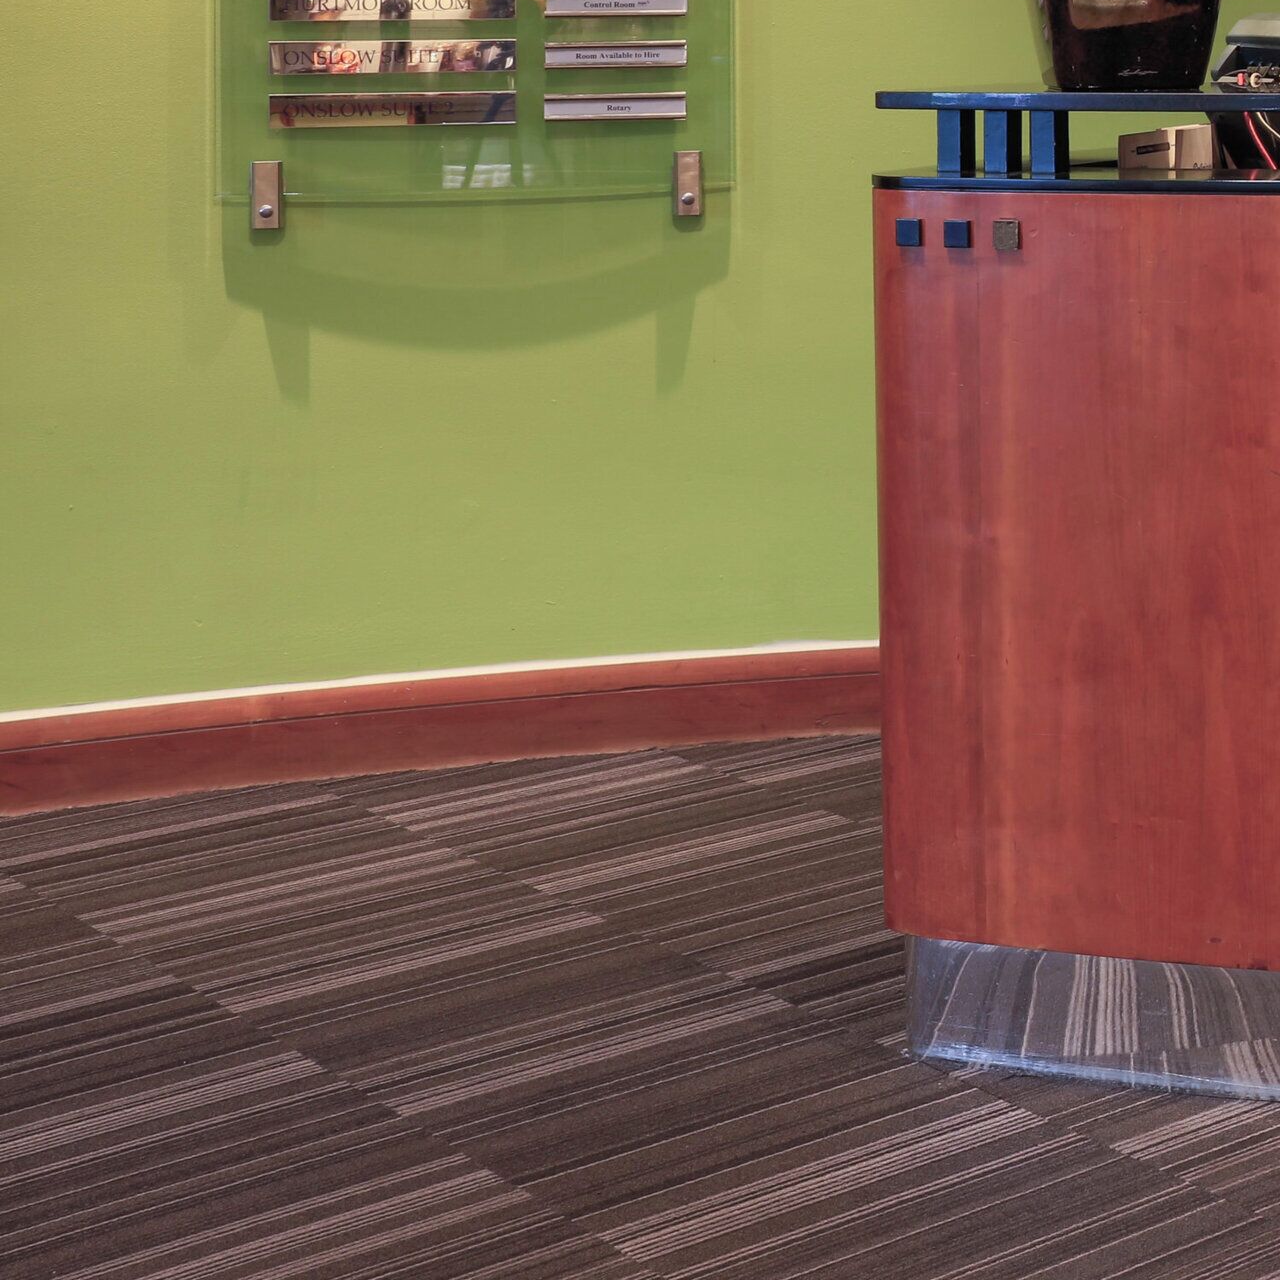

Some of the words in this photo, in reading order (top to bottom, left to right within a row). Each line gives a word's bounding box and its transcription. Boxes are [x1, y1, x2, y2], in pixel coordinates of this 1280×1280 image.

[583, 0, 612, 8] Control
[284, 50, 376, 65] ONSLOW
[382, 50, 438, 64] SUITE
[644, 51, 660, 59] Hire
[283, 102, 375, 118] ONSLOW
[607, 104, 631, 113] Rotary
